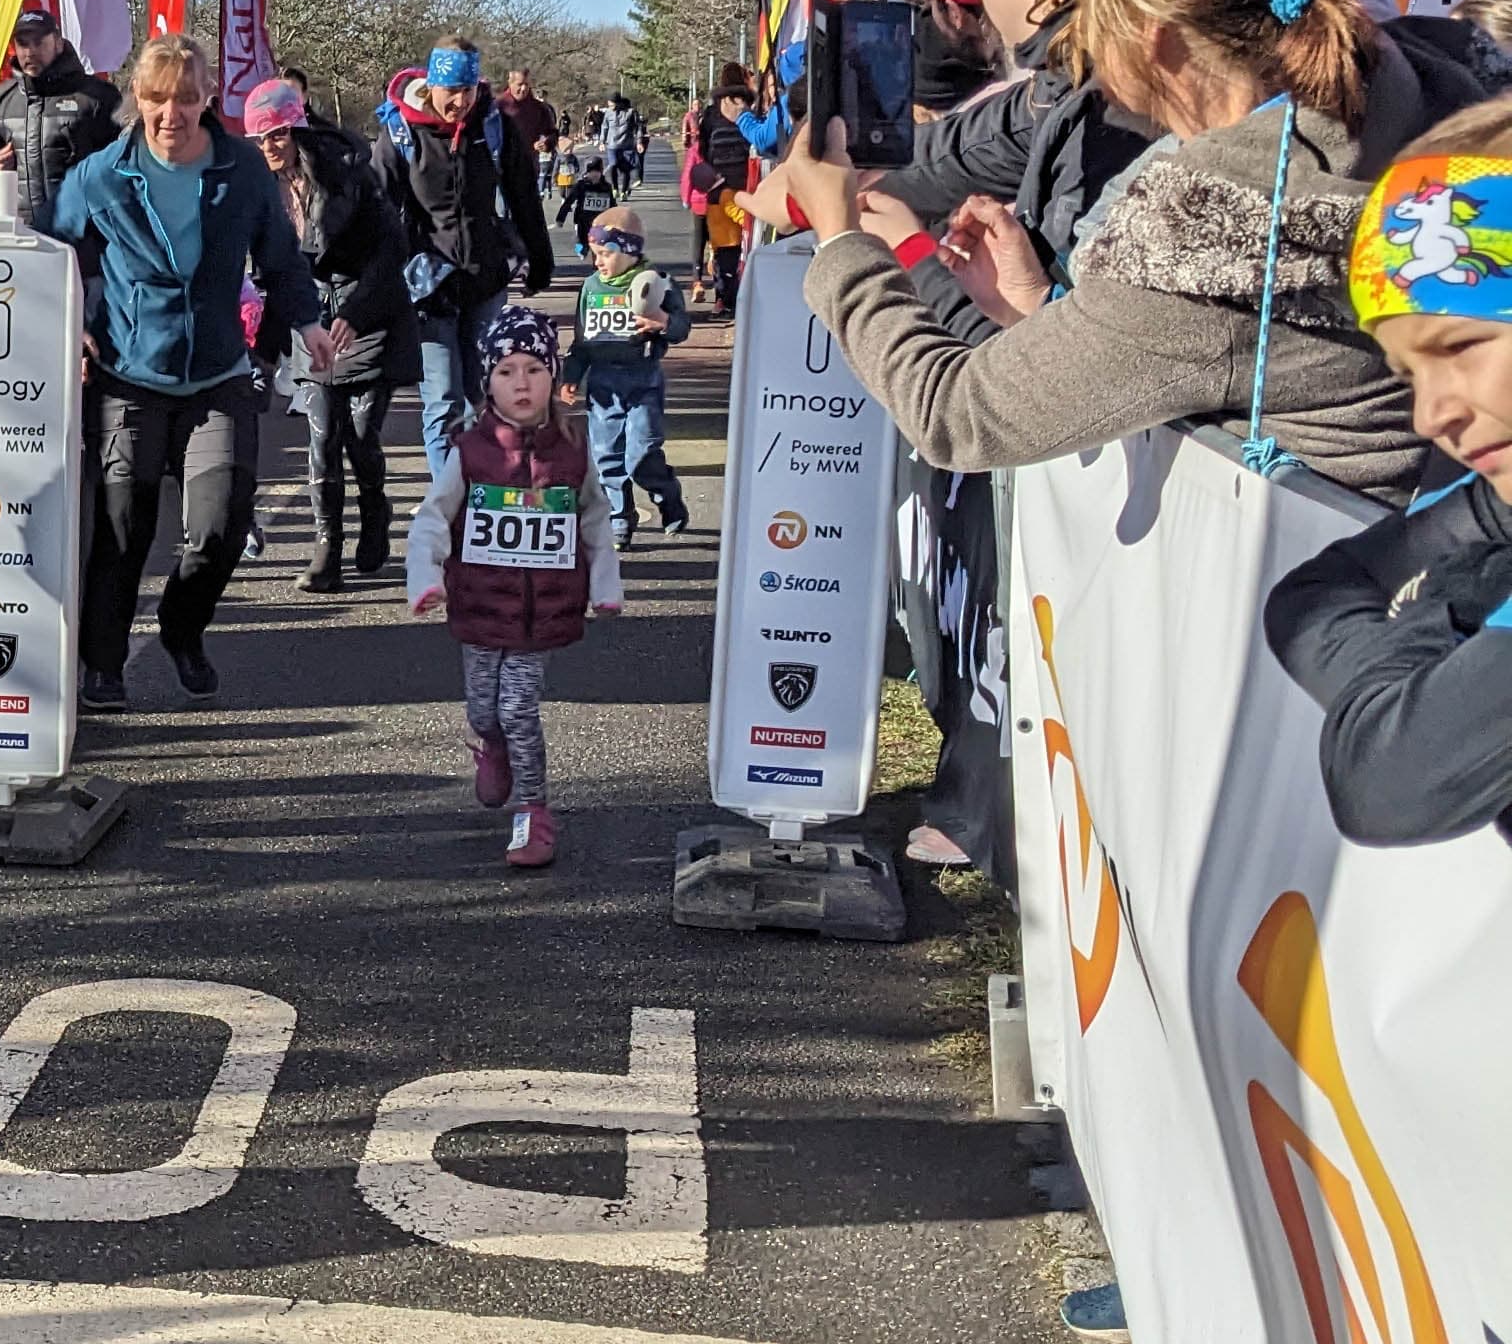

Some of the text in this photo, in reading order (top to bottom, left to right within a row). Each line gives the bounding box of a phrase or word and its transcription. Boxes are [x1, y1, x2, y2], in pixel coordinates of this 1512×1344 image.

[762, 387, 866, 418] innogy
[5, 440, 44, 454] MVM
[792, 440, 862, 456] Powered
[790, 458, 860, 474] by MVM
[7, 502, 33, 515] NN
[470, 512, 567, 552] 3015
[814, 526, 843, 540] NN
[783, 574, 841, 593] ŠKODA
[754, 730, 823, 746] NUTREND
